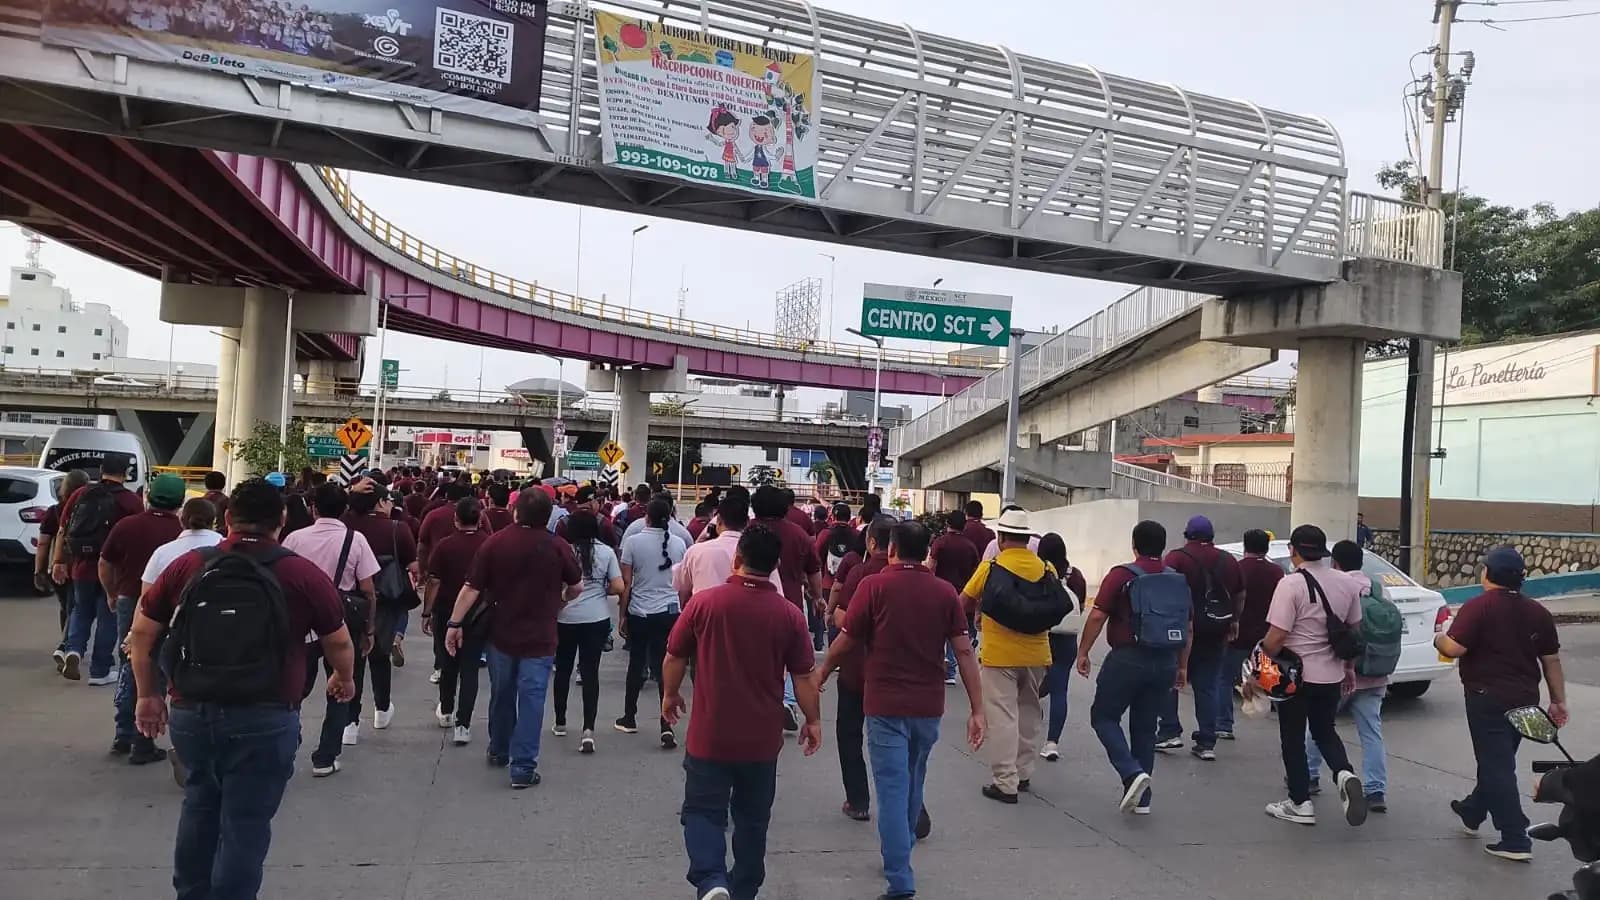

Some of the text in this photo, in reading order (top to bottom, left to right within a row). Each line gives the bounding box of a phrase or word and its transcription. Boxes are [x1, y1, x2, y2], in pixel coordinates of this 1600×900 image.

[519, 8, 535, 17] PM
[660, 23, 701, 42] AURORA
[703, 32, 742, 53] CORREA
[745, 42, 758, 57] DE
[761, 46, 797, 65] MENDEZ
[182, 50, 246, 69] DeBoleto
[652, 57, 724, 83] INSCRIPCIONES
[447, 80, 459, 88] TU
[657, 88, 711, 105] DESAYUNOS
[620, 149, 719, 180] 993-109-1078
[867, 306, 976, 336] CENTRO SCT
[1446, 361, 1547, 389] La Panettería
